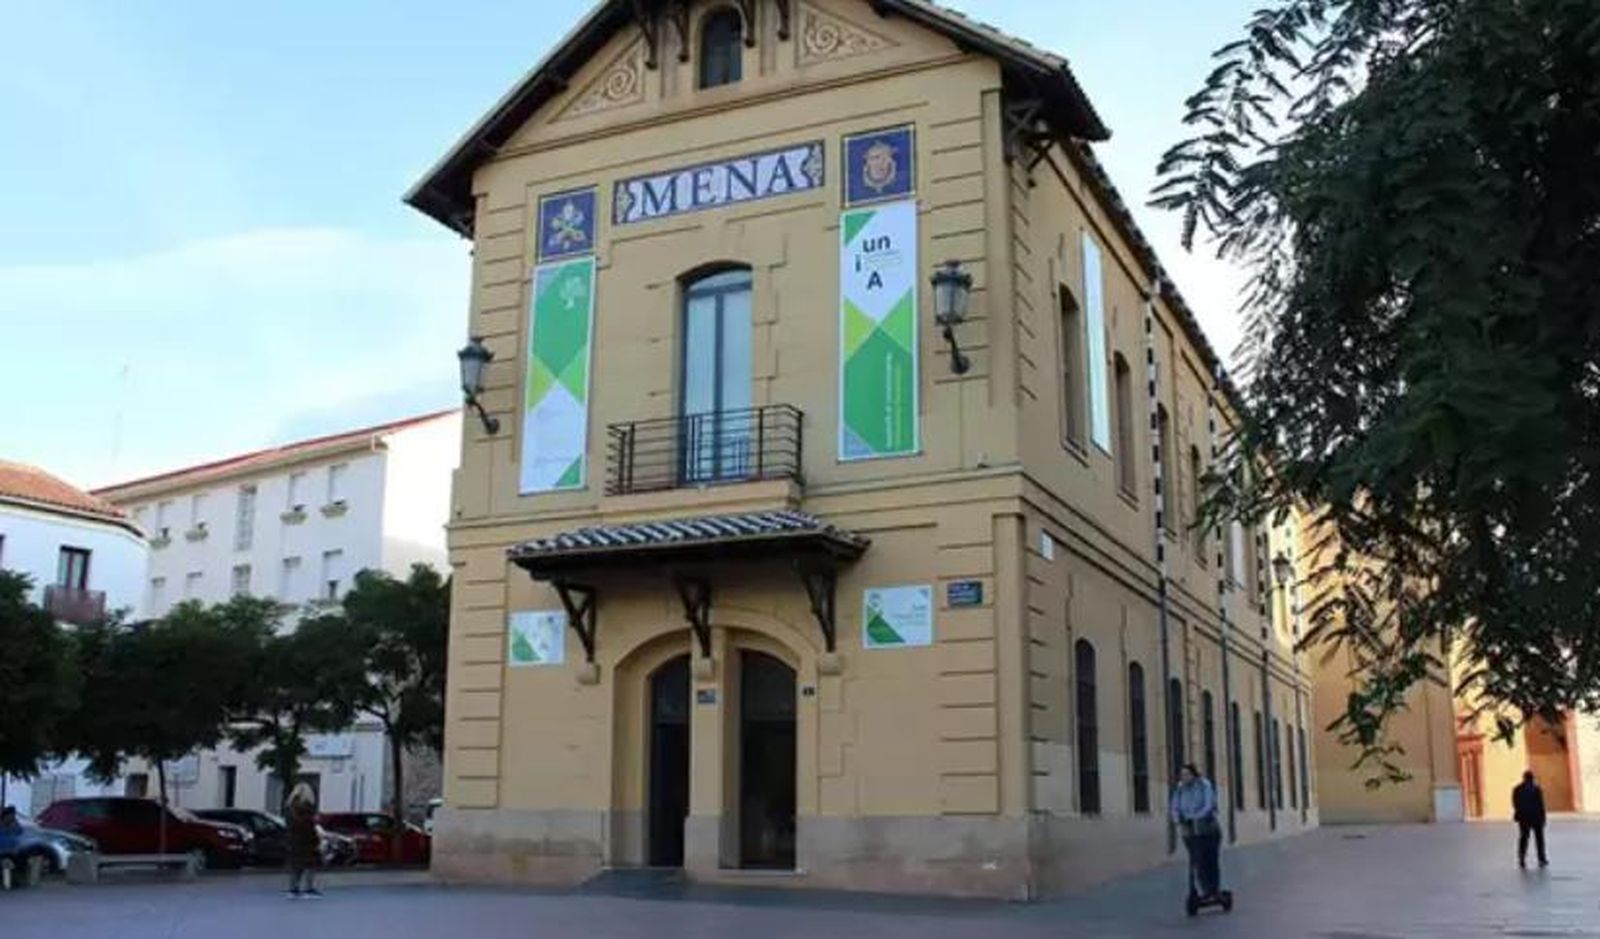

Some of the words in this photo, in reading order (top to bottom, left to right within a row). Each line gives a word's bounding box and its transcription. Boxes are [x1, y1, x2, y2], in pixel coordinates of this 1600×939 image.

[640, 155, 798, 217] MENA
[862, 235, 891, 253] un
[867, 270, 884, 290] A
